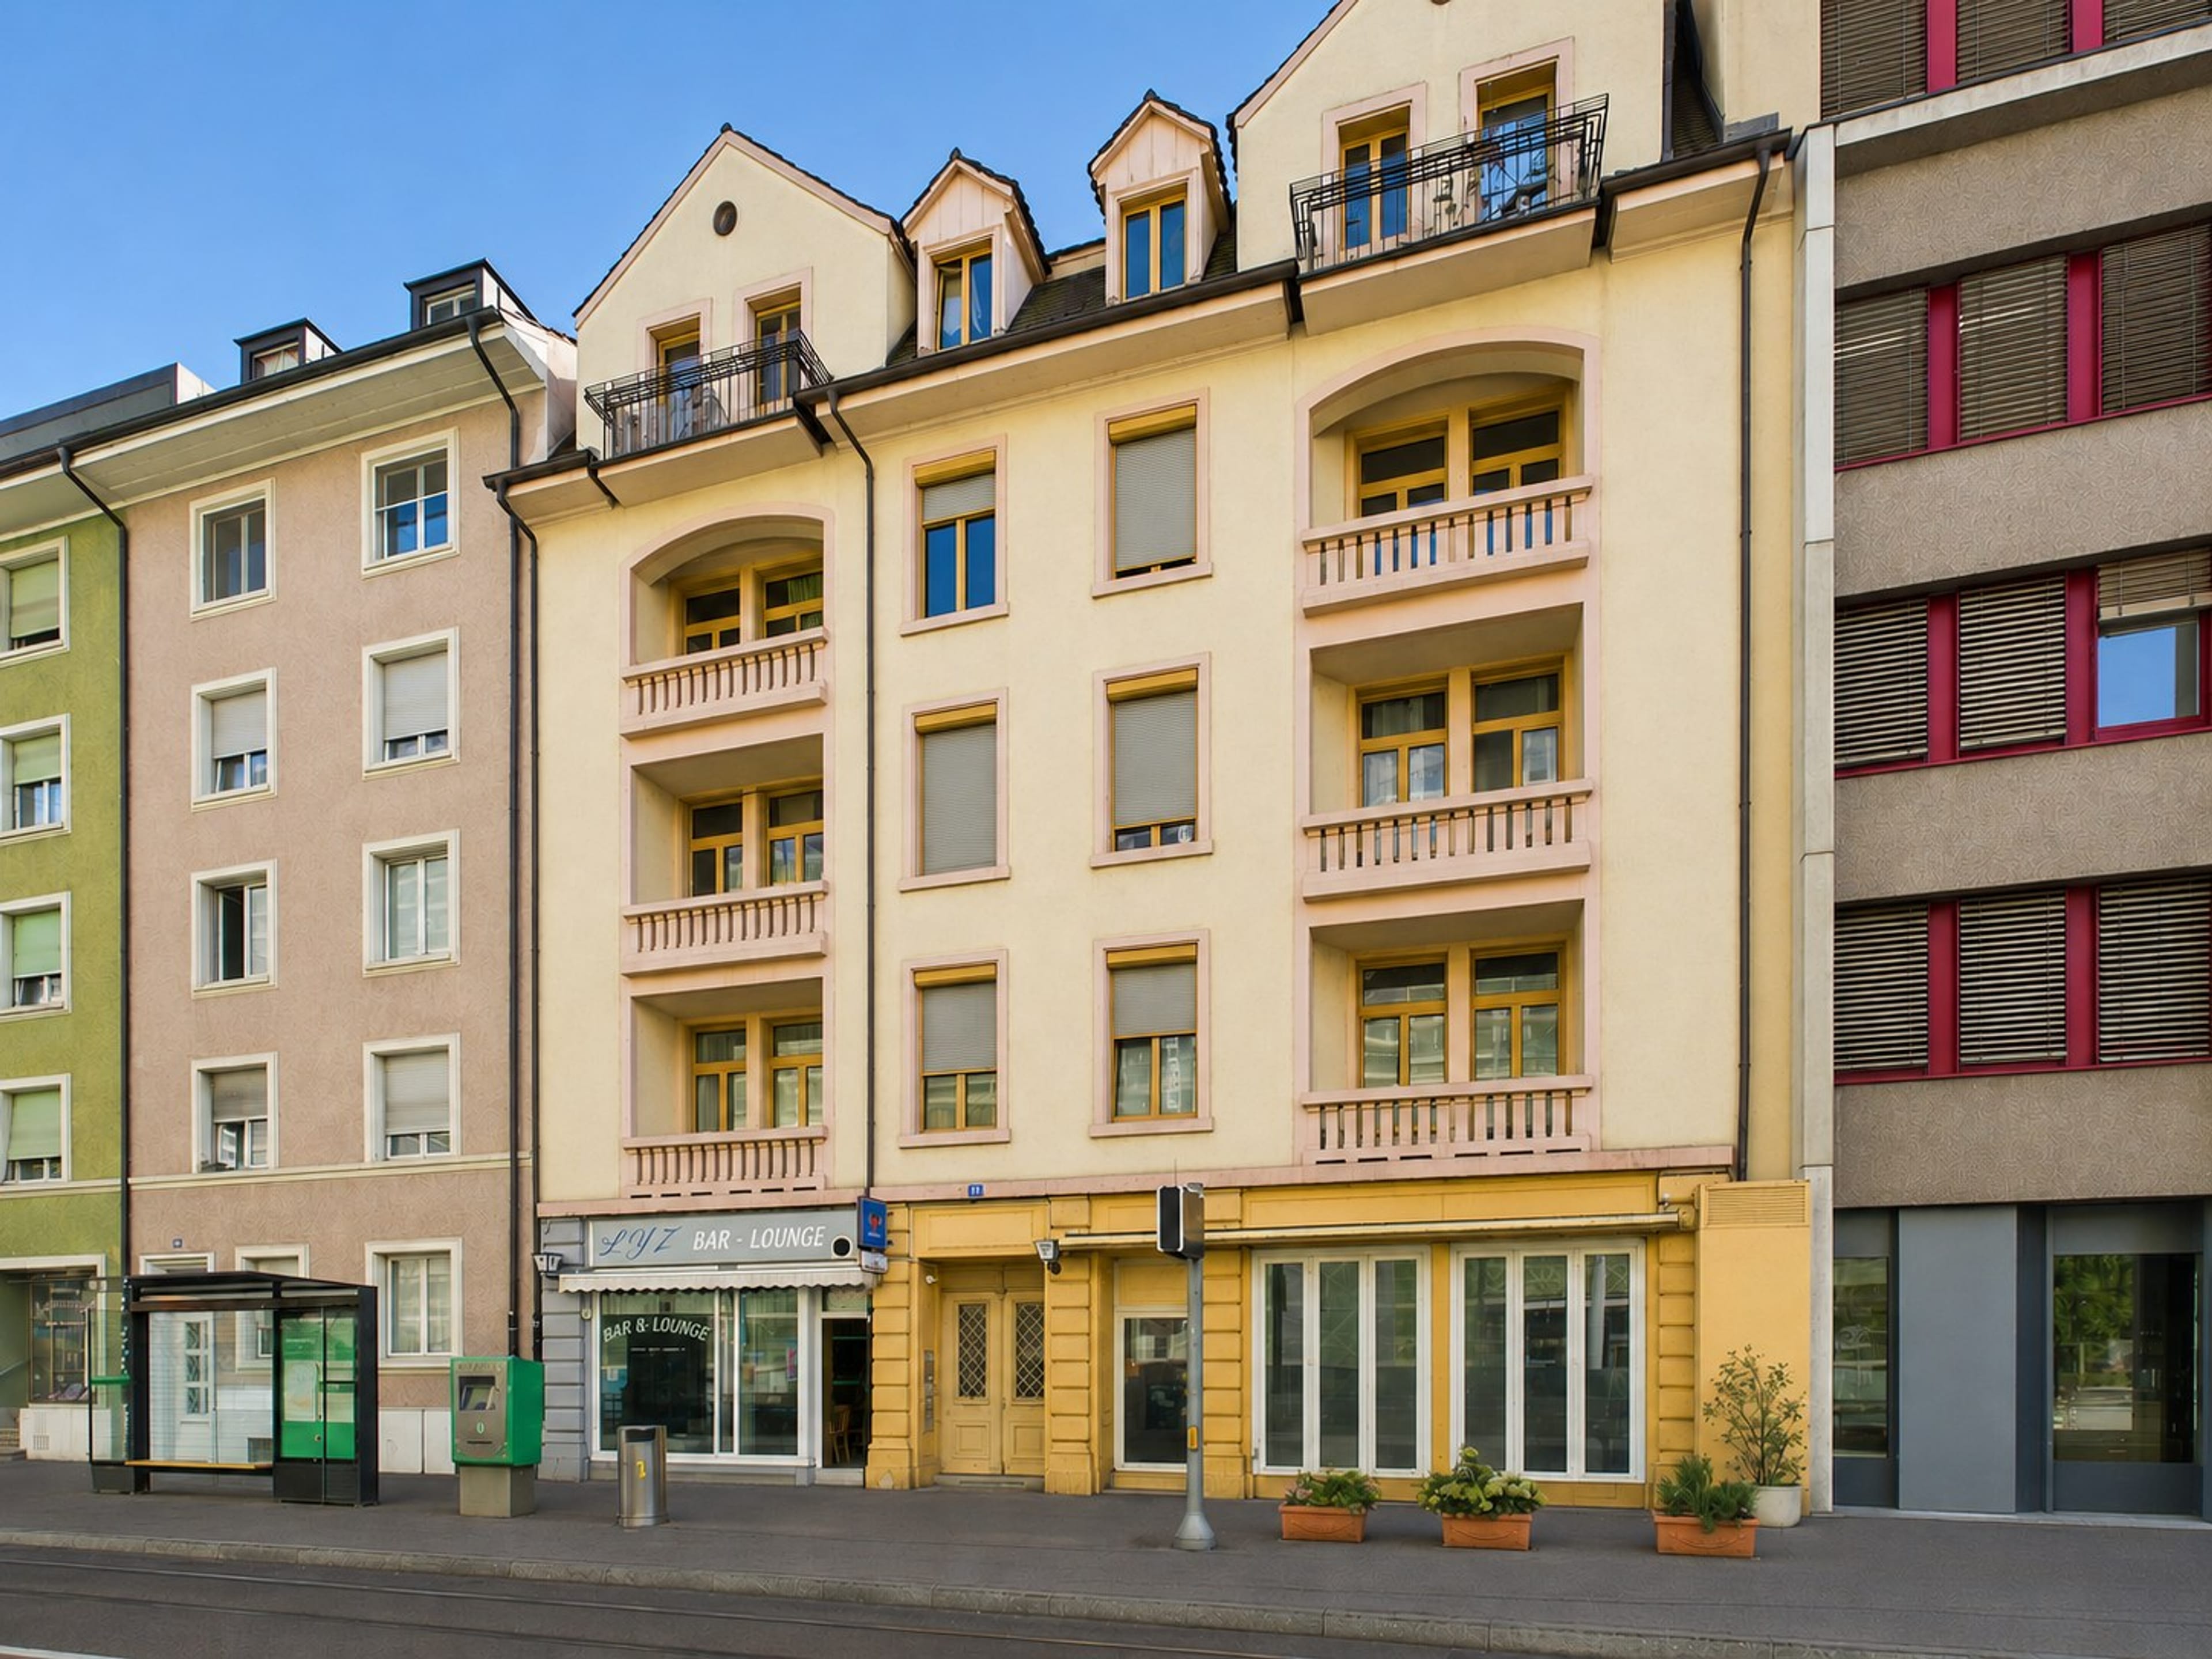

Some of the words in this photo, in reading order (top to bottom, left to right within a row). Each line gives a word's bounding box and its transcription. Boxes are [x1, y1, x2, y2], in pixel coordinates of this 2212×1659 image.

[693, 1230, 730, 1251] BAR
[750, 1225, 826, 1249] LOUNGE
[603, 1320, 632, 1343] BAR
[652, 1316, 711, 1341] LOUNGE
